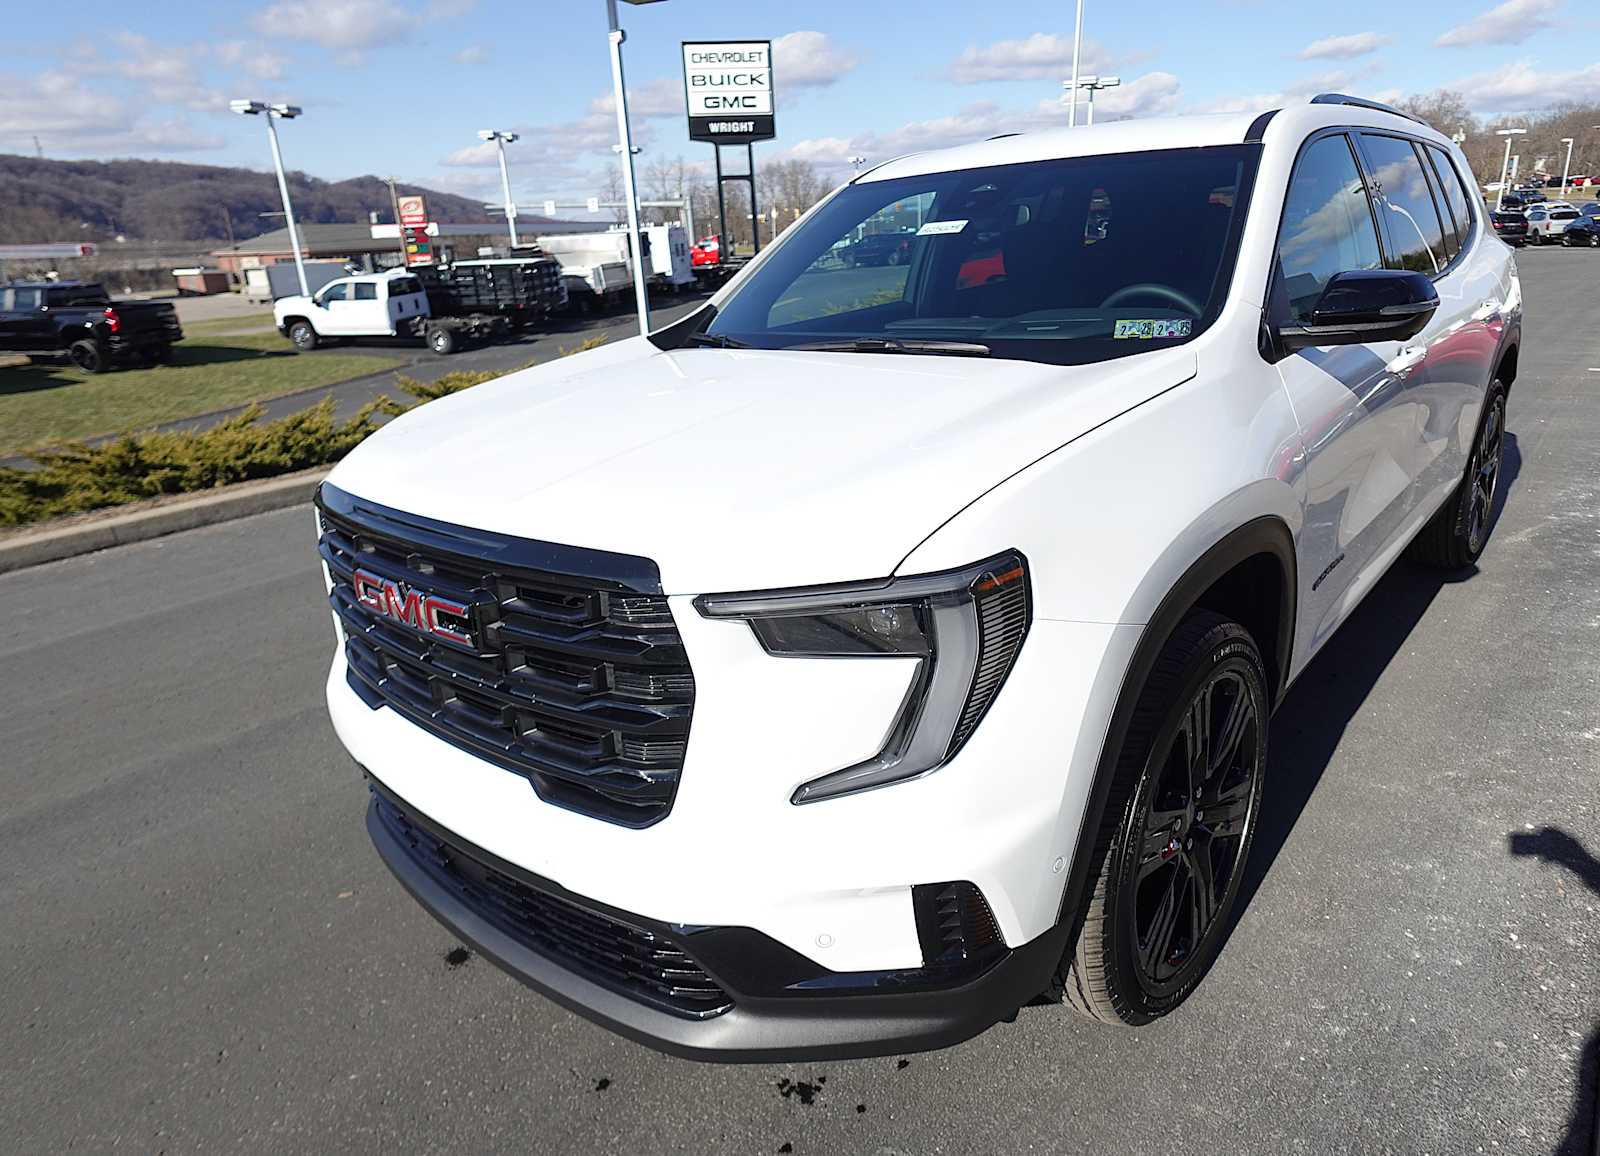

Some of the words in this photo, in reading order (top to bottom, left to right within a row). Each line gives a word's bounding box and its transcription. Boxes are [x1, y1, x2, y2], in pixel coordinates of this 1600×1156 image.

[691, 51, 763, 63] CHEVROLET
[691, 73, 765, 86] BUICK
[704, 96, 757, 109] GMC
[708, 121, 755, 133] WRIGHT
[353, 568, 475, 648] GMC
